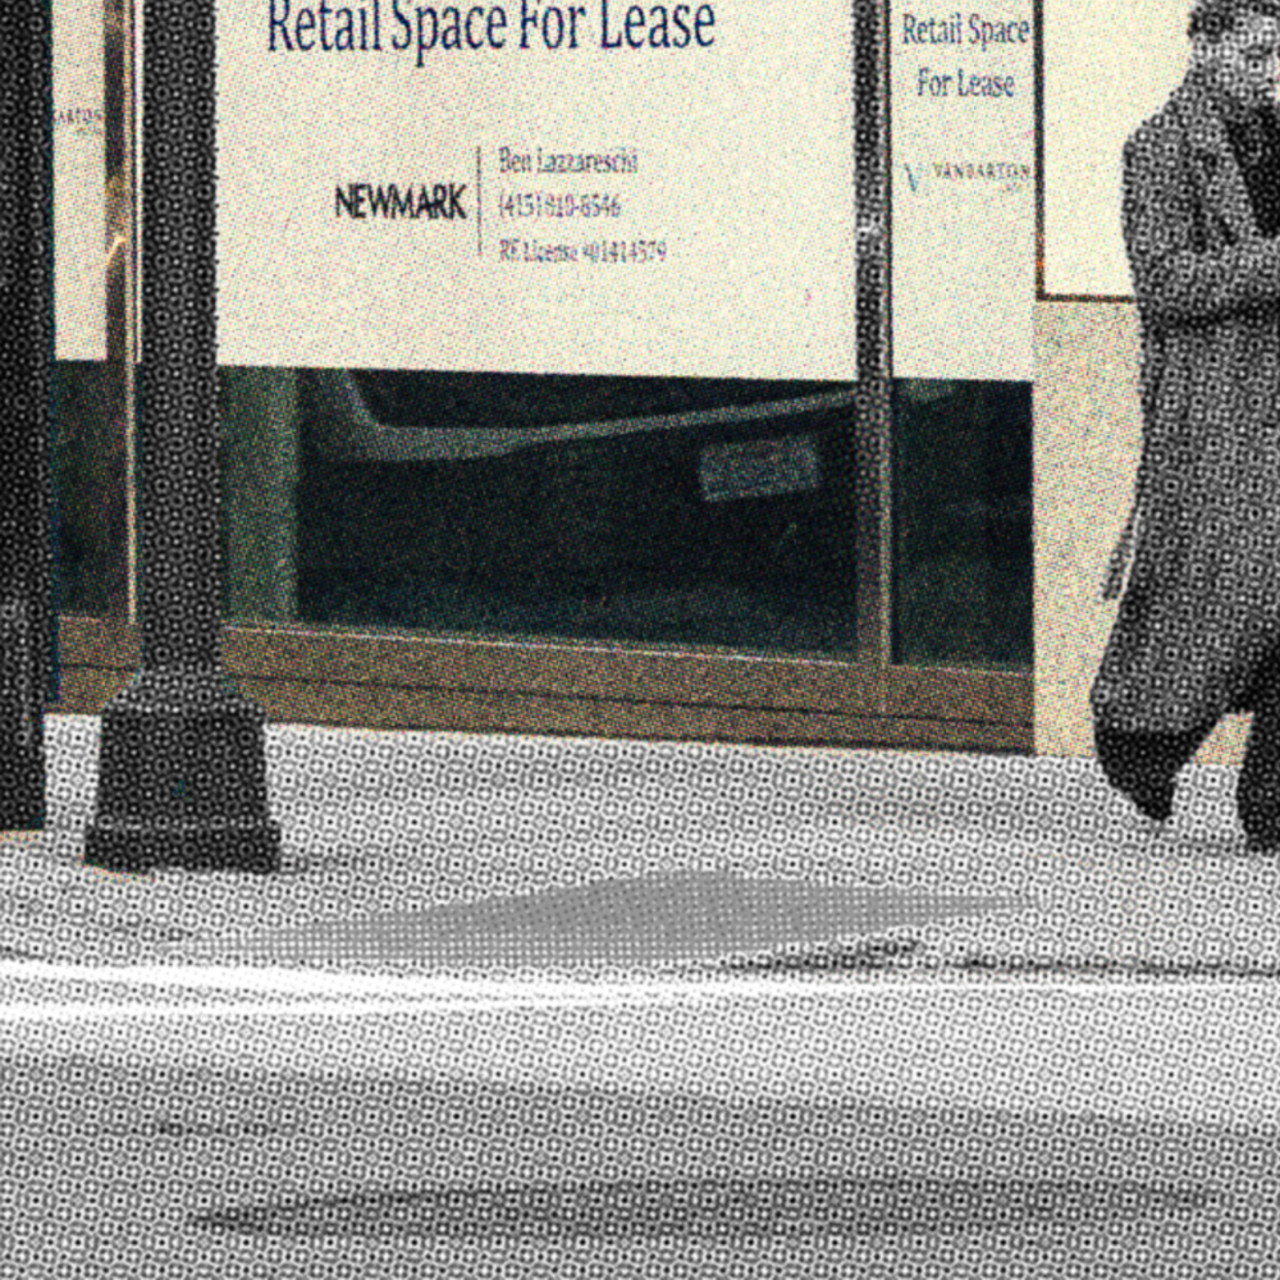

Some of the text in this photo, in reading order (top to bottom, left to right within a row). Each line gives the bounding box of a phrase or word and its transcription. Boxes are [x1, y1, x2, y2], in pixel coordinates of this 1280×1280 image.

[902, 11, 1031, 52] Retail Space
[917, 67, 1015, 98] For Lease
[499, 145, 532, 174] Ben
[335, 183, 467, 220] NEWMARK
